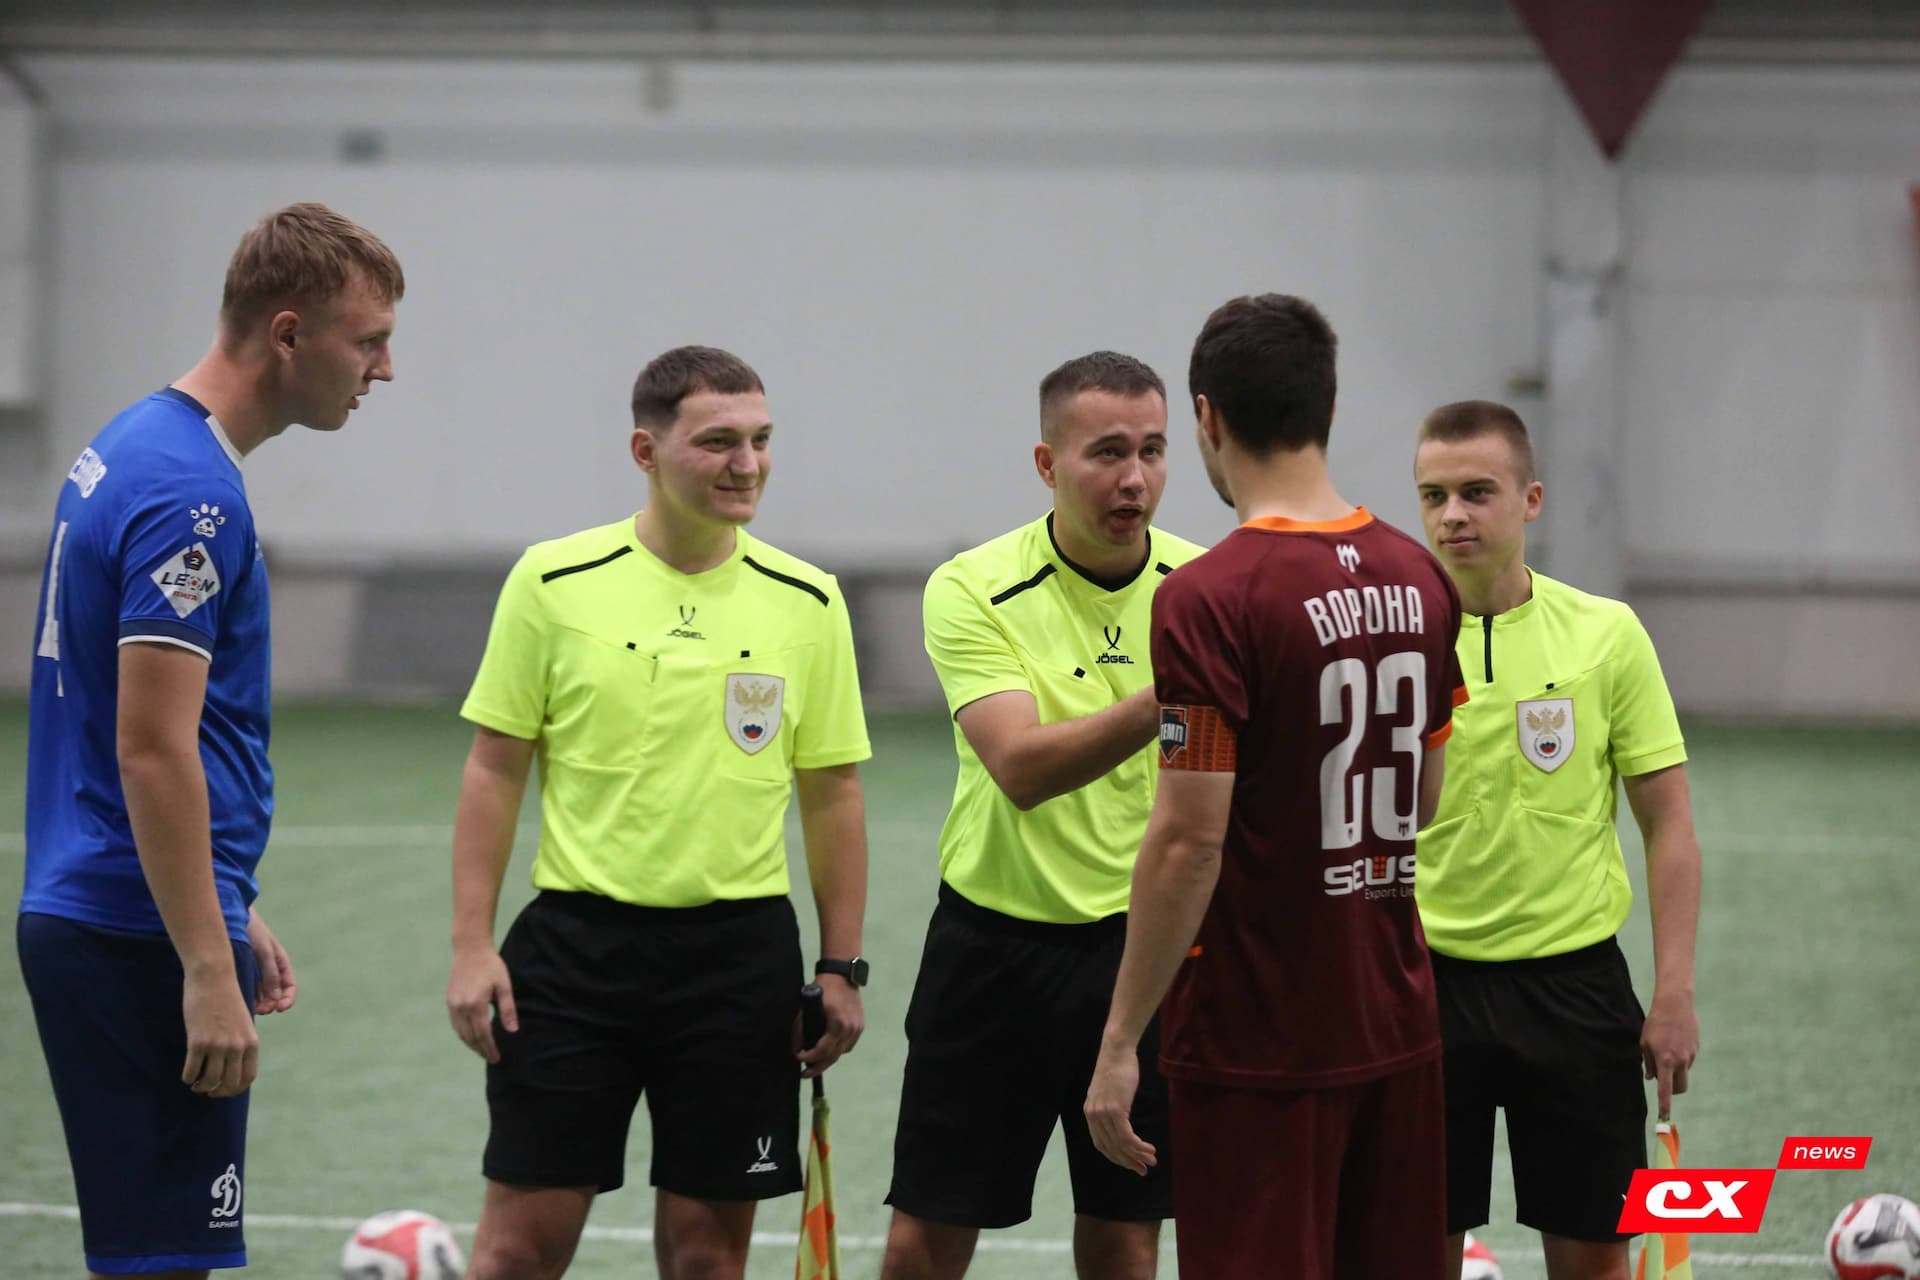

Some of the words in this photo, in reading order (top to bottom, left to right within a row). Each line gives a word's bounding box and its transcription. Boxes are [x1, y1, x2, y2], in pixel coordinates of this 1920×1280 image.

[161, 572, 215, 592] LEON
[1304, 585, 1424, 646] ВОРОНА
[1095, 653, 1134, 664] JÖGEL
[1319, 651, 1427, 850] 23
[1364, 887, 1396, 901] Export
